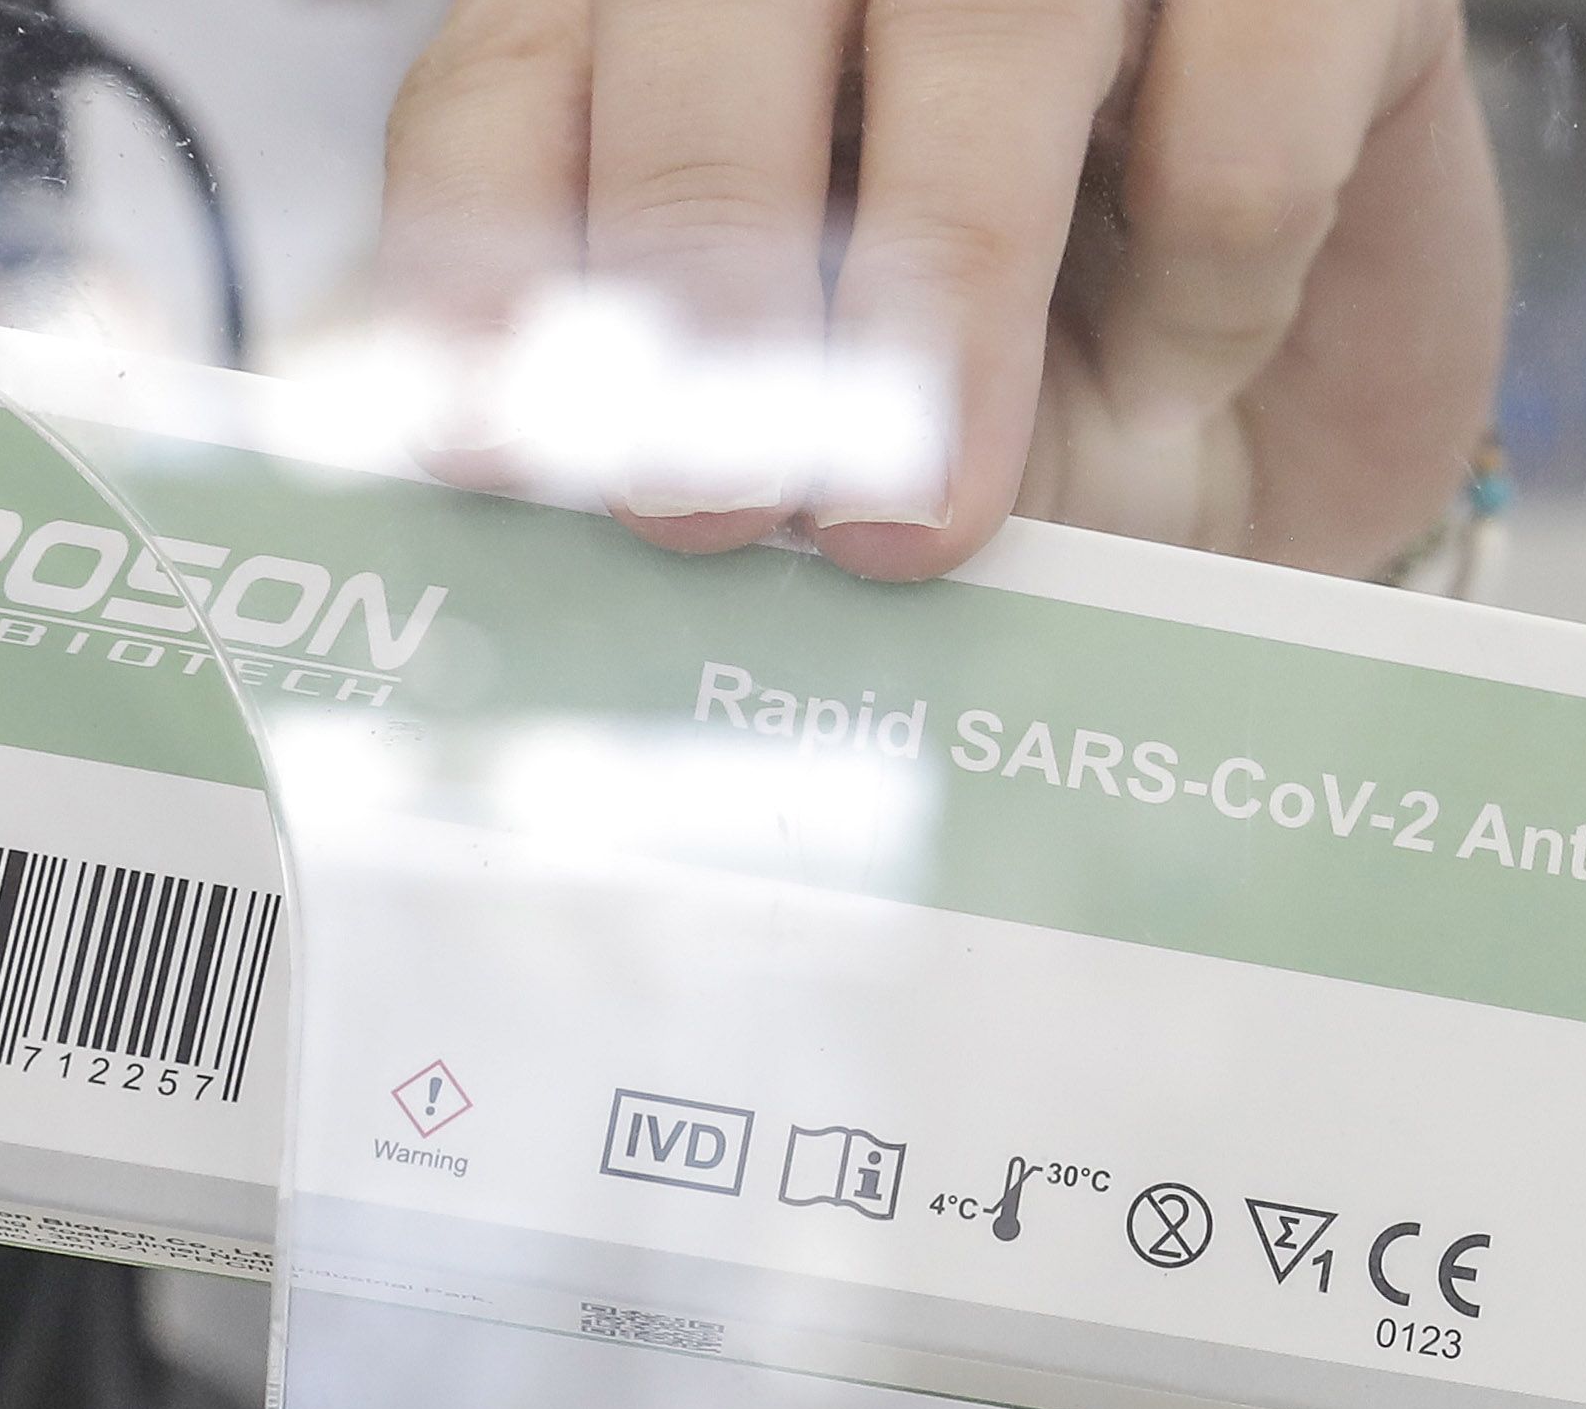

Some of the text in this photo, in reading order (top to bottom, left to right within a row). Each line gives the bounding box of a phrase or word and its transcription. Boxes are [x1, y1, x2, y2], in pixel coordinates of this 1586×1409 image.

[693, 660, 929, 761] Rapid
[949, 709, 1441, 854] SARS-CoV-2
[373, 1138, 470, 1178] Warning
[41, 1217, 156, 1241] Biotech
[626, 1112, 727, 1170] IVD
[1368, 1221, 1492, 1319] CE
[1376, 1316, 1464, 1361] 0123
